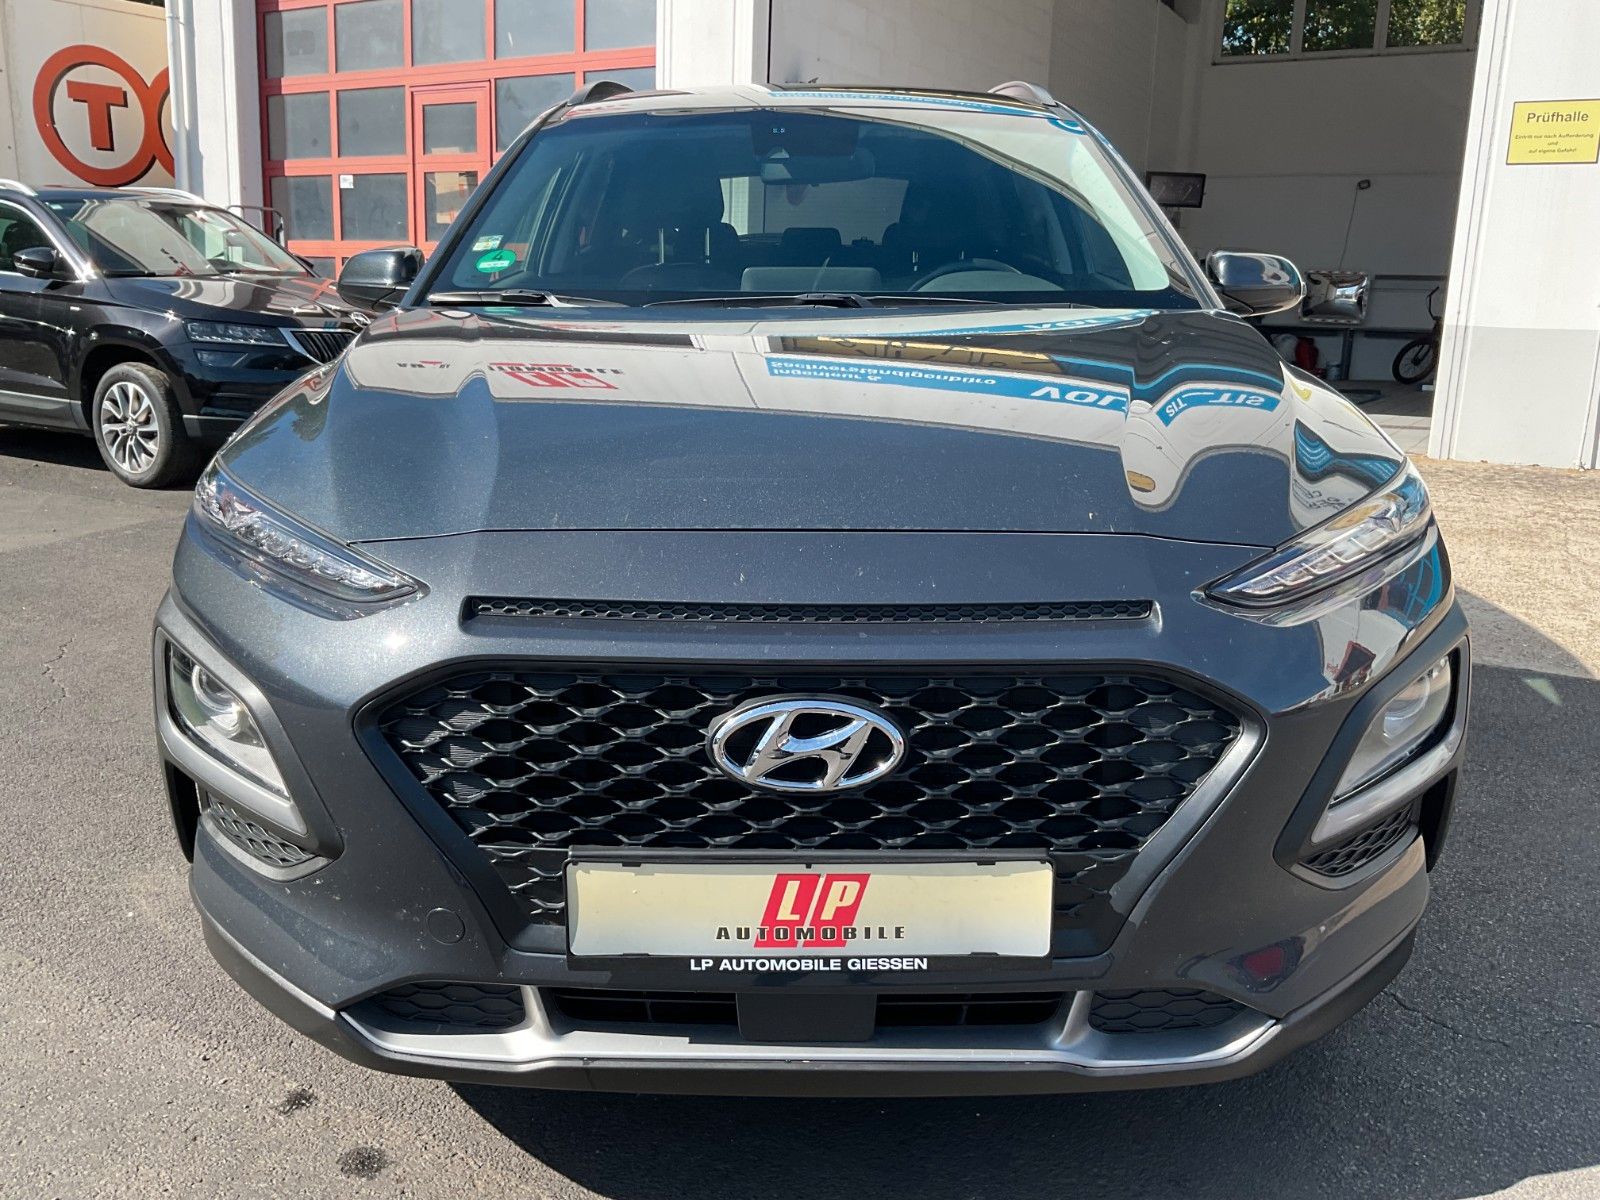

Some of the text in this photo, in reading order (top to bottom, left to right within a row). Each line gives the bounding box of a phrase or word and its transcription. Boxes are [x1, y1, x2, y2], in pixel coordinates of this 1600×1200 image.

[1527, 111, 1589, 123] Prüfhalle
[491, 250, 504, 261] 4
[774, 880, 861, 921] LP
[715, 925, 906, 941] AUTOMOBILE
[690, 957, 928, 971] LP AUTOMOBILE GIESSEN
